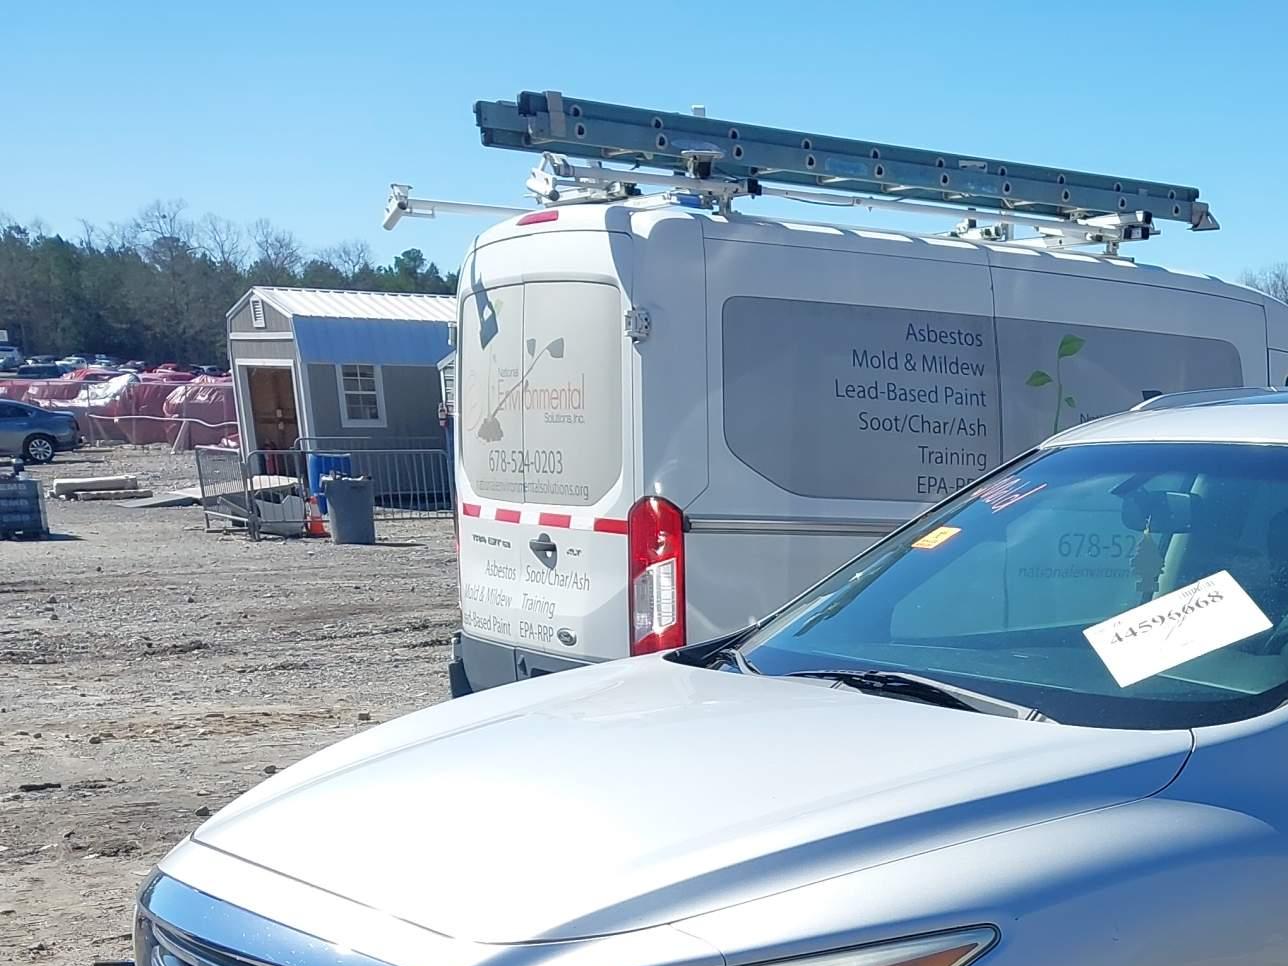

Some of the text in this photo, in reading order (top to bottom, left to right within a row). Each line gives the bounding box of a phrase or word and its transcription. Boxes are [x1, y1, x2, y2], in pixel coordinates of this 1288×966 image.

[905, 322, 983, 347] Asbestos
[852, 349, 985, 377] Mold & Mildew
[835, 378, 987, 408] Lead-Based Paint
[858, 411, 987, 437] Soot/Char/Ash
[488, 450, 564, 475] 678-524-0203
[918, 445, 987, 471] Training
[1058, 533, 1137, 559] 678-52
[485, 560, 516, 581] Asbestos
[525, 564, 590, 592] Soot/Char/Ash
[486, 587, 513, 608] Mildew
[521, 592, 556, 619] Training
[463, 609, 511, 636] ead-Based Paint
[1110, 590, 1225, 645] 44596668
[519, 620, 554, 643] EPA-RRP
